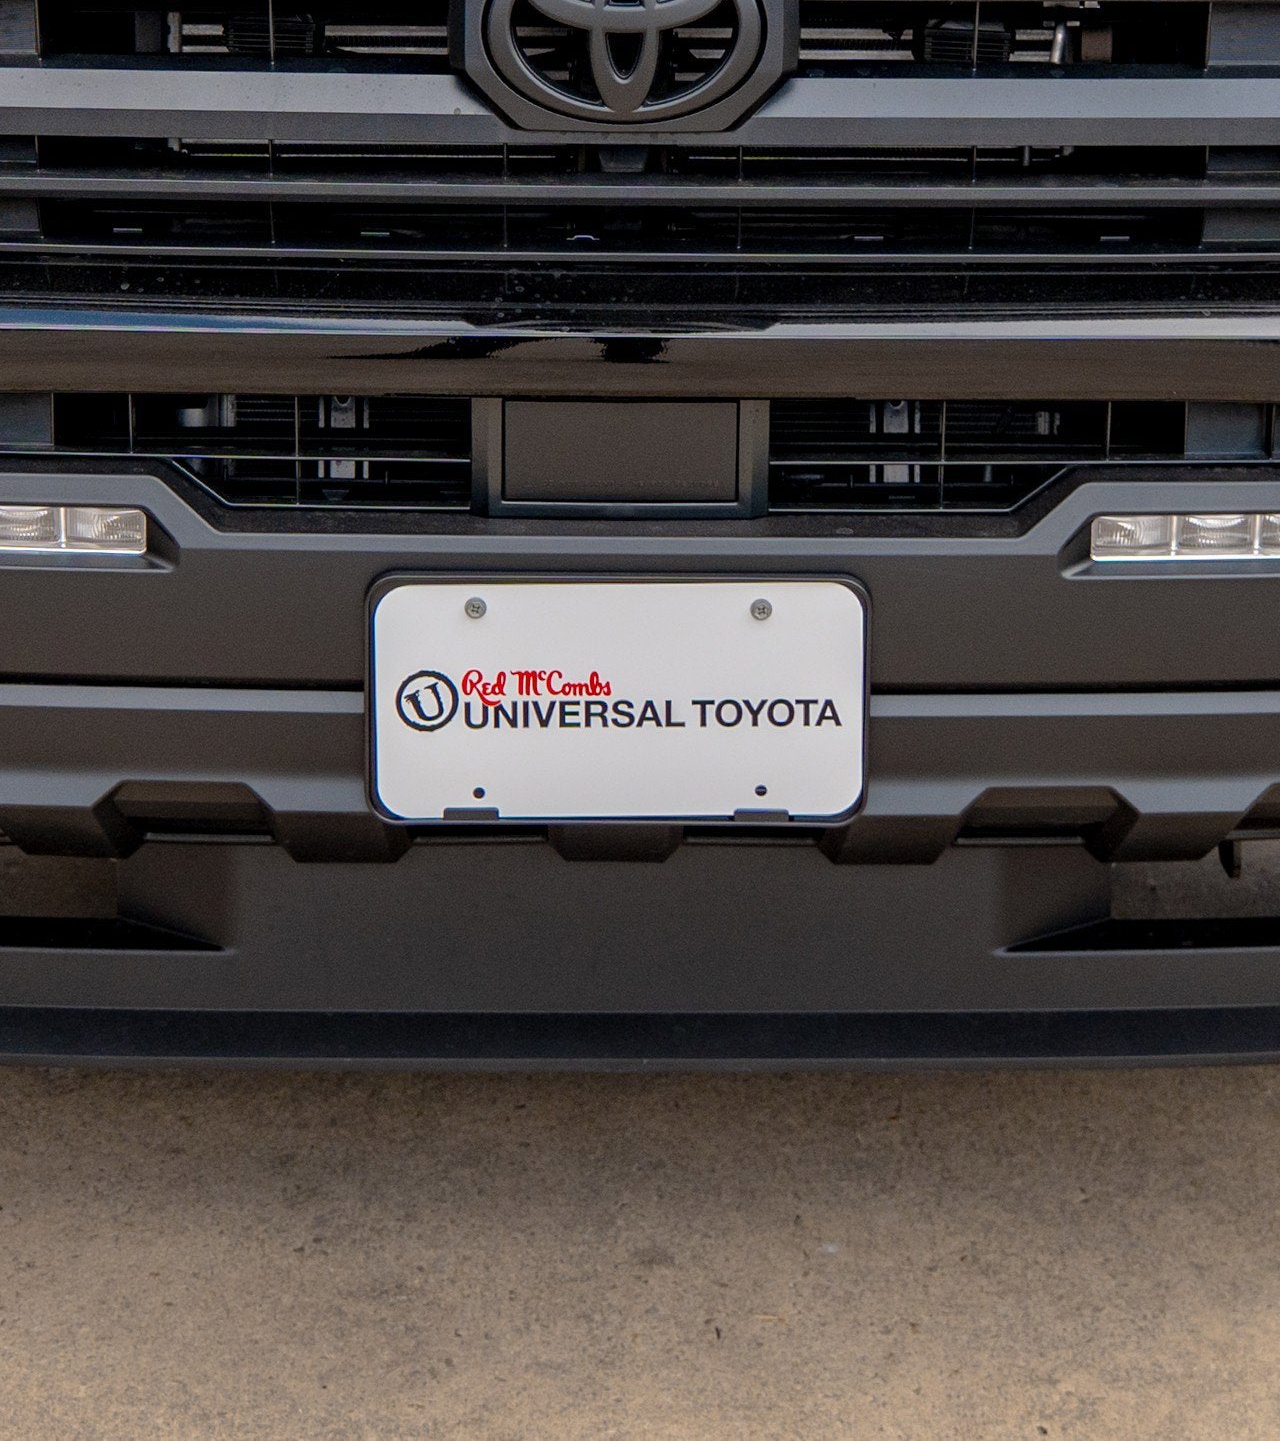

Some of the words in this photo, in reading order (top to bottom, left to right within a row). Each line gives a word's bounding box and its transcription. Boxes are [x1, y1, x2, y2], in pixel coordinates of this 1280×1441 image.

[461, 669, 507, 707] Red
[510, 670, 612, 697] McCombs
[463, 699, 686, 729] UNIVERSAL
[691, 698, 842, 727] TOYOTA
